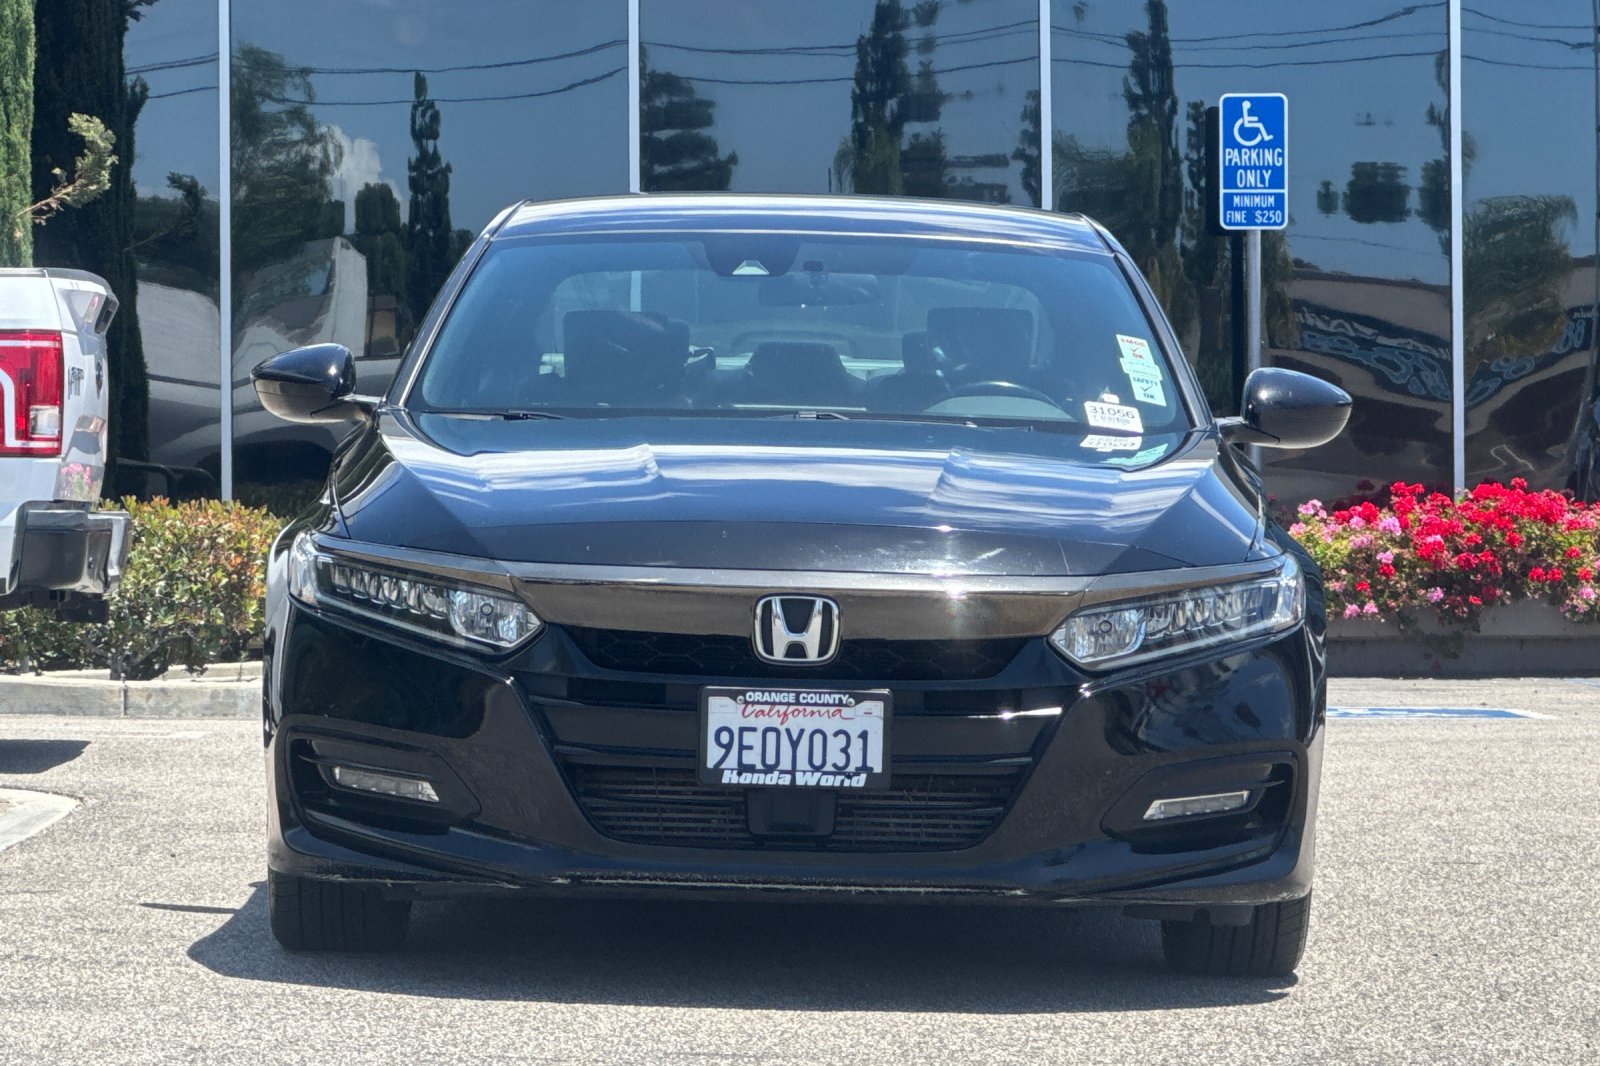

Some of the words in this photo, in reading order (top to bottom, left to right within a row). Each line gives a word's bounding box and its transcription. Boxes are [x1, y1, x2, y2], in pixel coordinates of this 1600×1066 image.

[1225, 148, 1283, 167] PARKING
[1236, 169, 1272, 188] ONLY
[1233, 195, 1275, 208] MINIMUM
[1226, 210, 1247, 223] FINE
[1254, 210, 1282, 224] $250
[1132, 376, 1158, 387] SAFETY
[1143, 392, 1156, 401] OK
[1089, 405, 1136, 419] 31056
[745, 691, 796, 703] ORANGE
[799, 693, 849, 705] COUNTY
[741, 703, 855, 726] California
[721, 770, 791, 786] Honda
[795, 771, 868, 788] World
